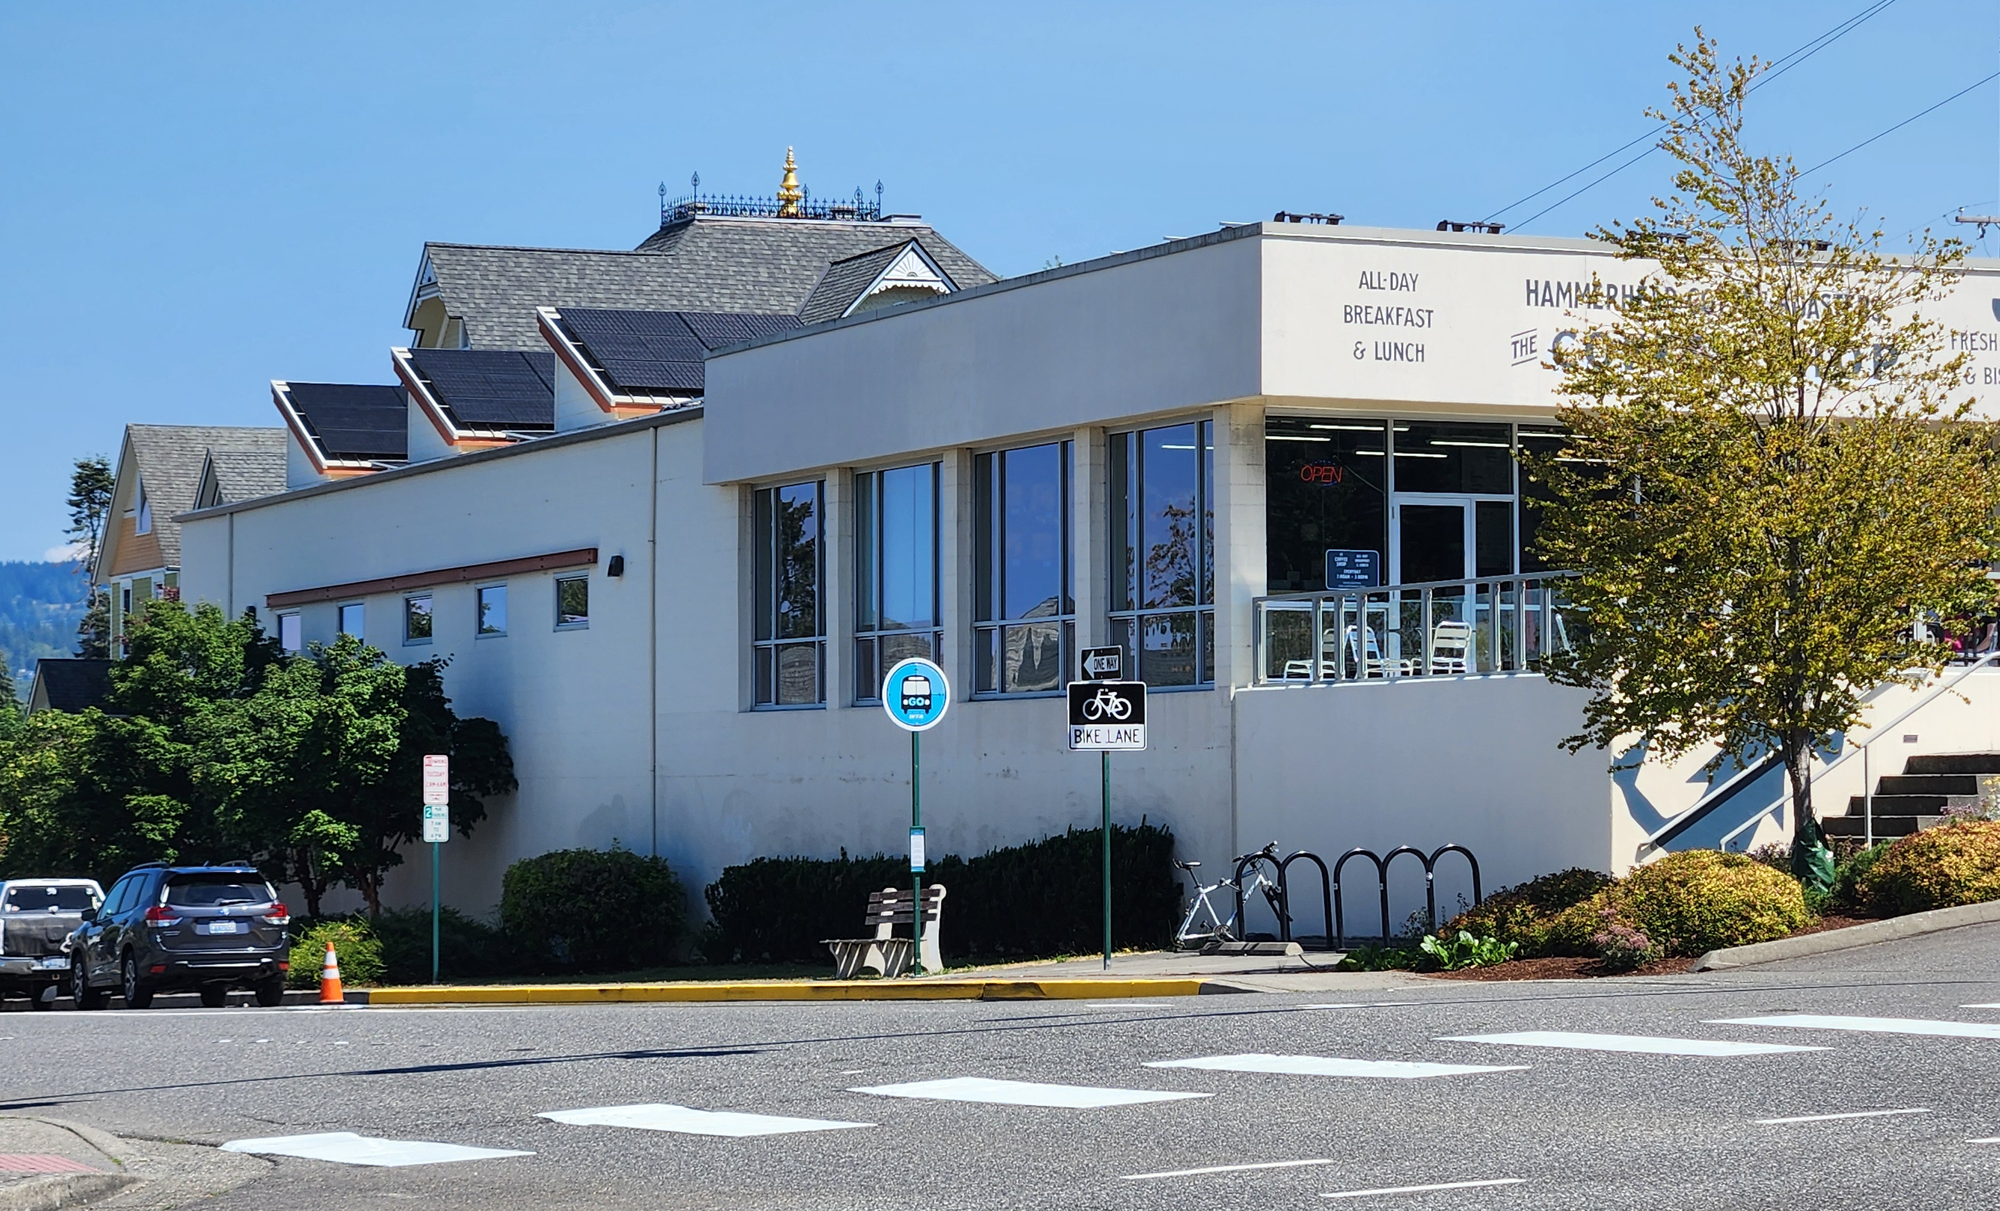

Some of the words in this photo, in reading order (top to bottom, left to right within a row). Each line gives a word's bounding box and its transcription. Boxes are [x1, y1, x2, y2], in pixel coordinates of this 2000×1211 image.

[1526, 278, 1677, 313] HAMMRH
[1343, 304, 1434, 329] BREAKFAST
[1353, 340, 1366, 360] &
[1374, 340, 1425, 363] LUNCH
[1511, 334, 1538, 360] THE
[1950, 332, 1998, 352] FRESH
[1300, 464, 1343, 483] OPEN
[1093, 657, 1105, 671] ONE
[1106, 656, 1118, 670] WAY
[908, 696, 925, 707] GO
[1074, 728, 1101, 744] BIKE
[1105, 728, 1140, 744] LANE
[426, 807, 432, 818] 2
